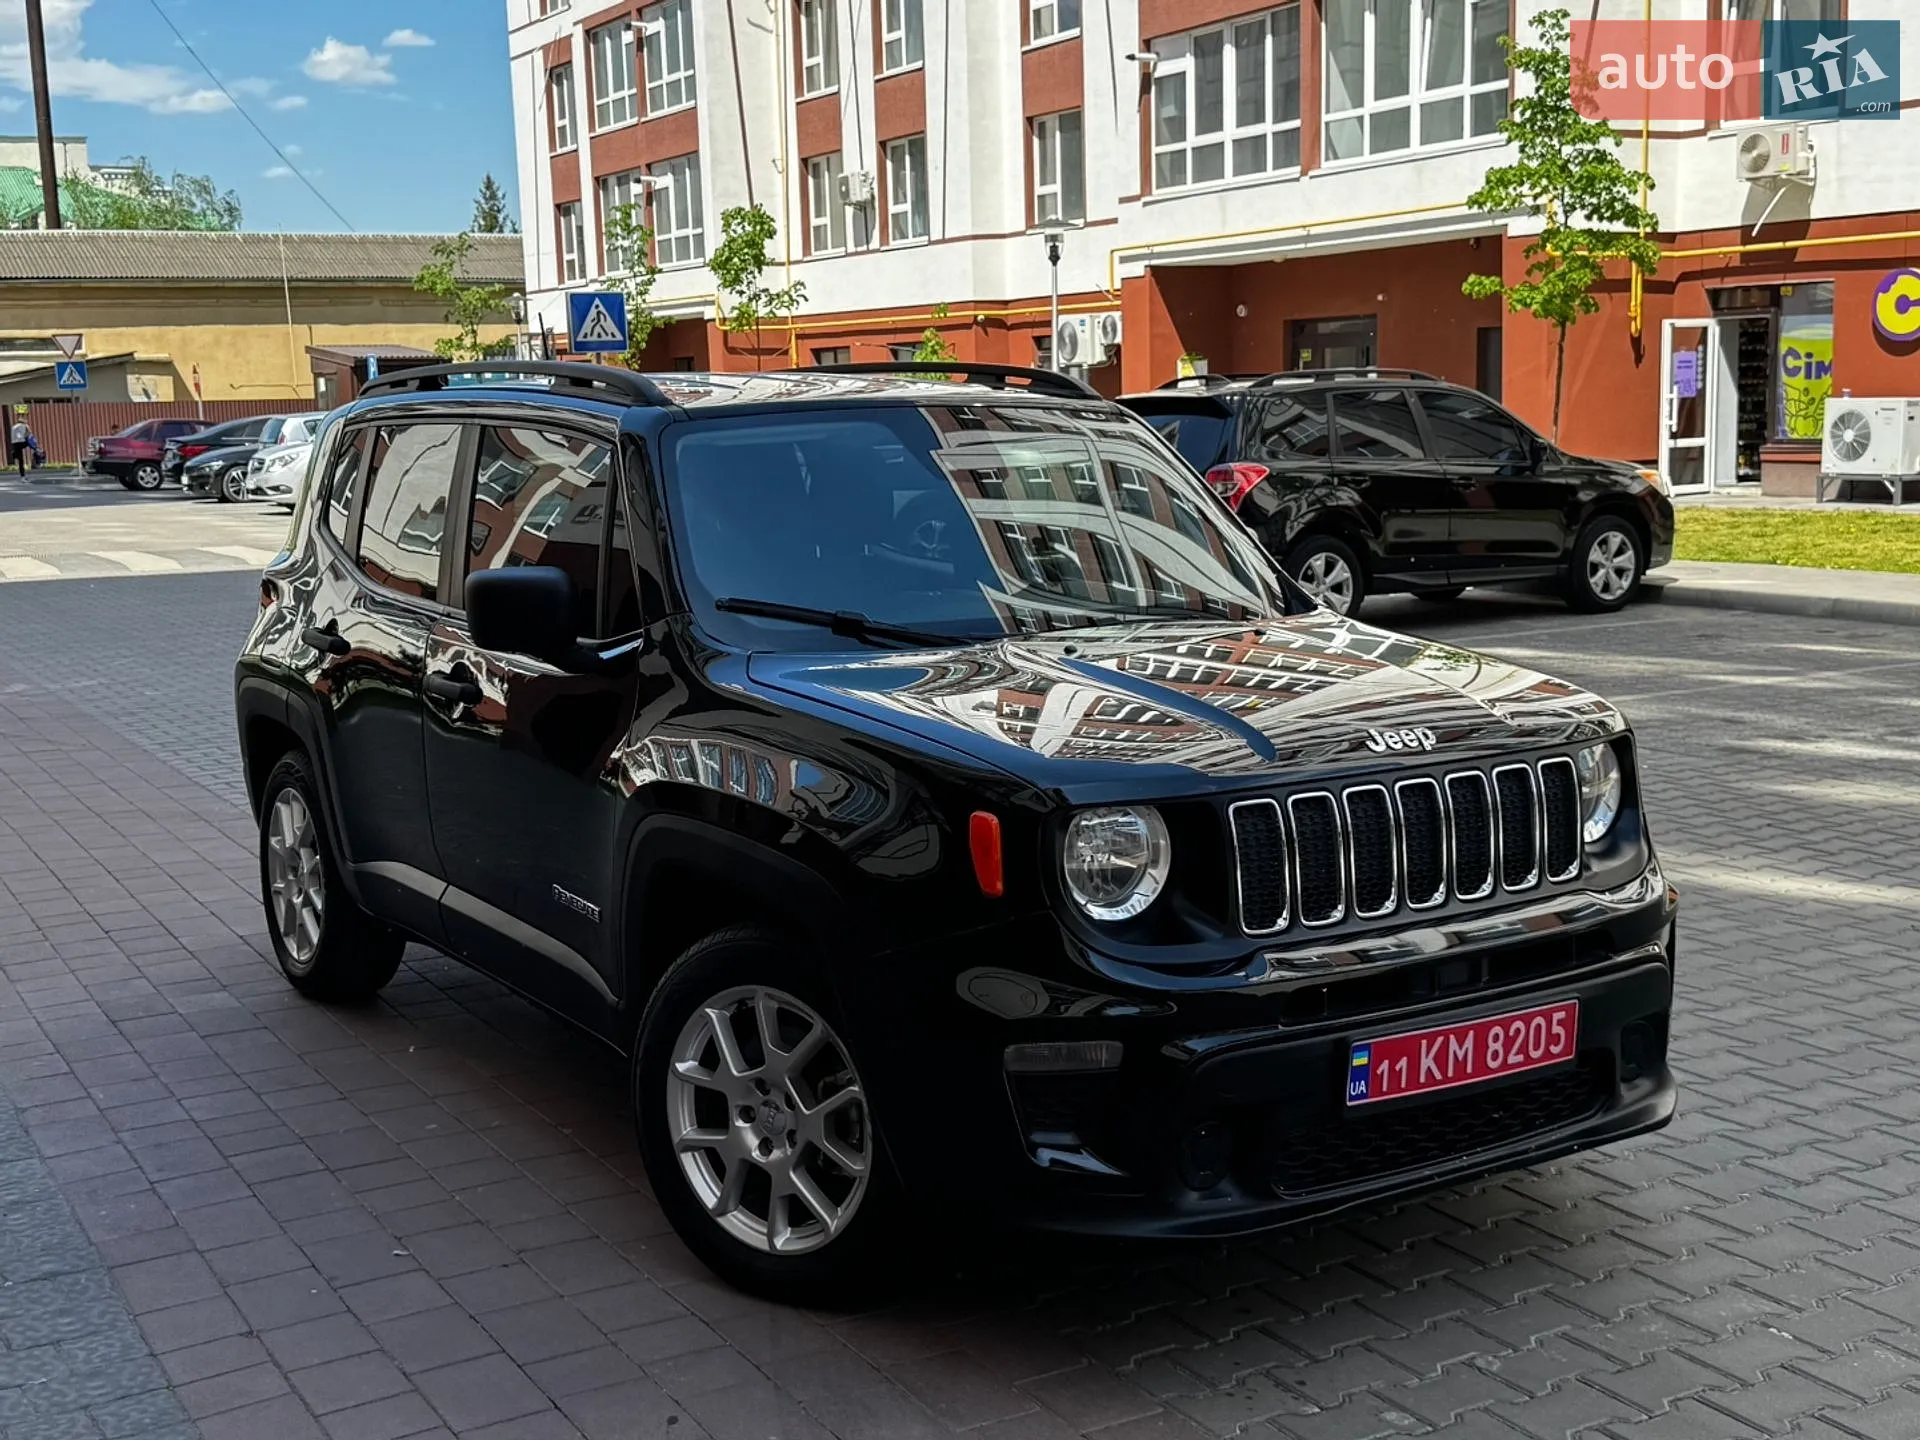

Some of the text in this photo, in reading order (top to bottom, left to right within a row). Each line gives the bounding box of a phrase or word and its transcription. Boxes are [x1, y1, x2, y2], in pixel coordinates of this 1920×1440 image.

[1365, 727, 1436, 752] Jeep
[1376, 1010, 1567, 1092] 11 KM 8205
[1349, 1080, 1367, 1096] UA
